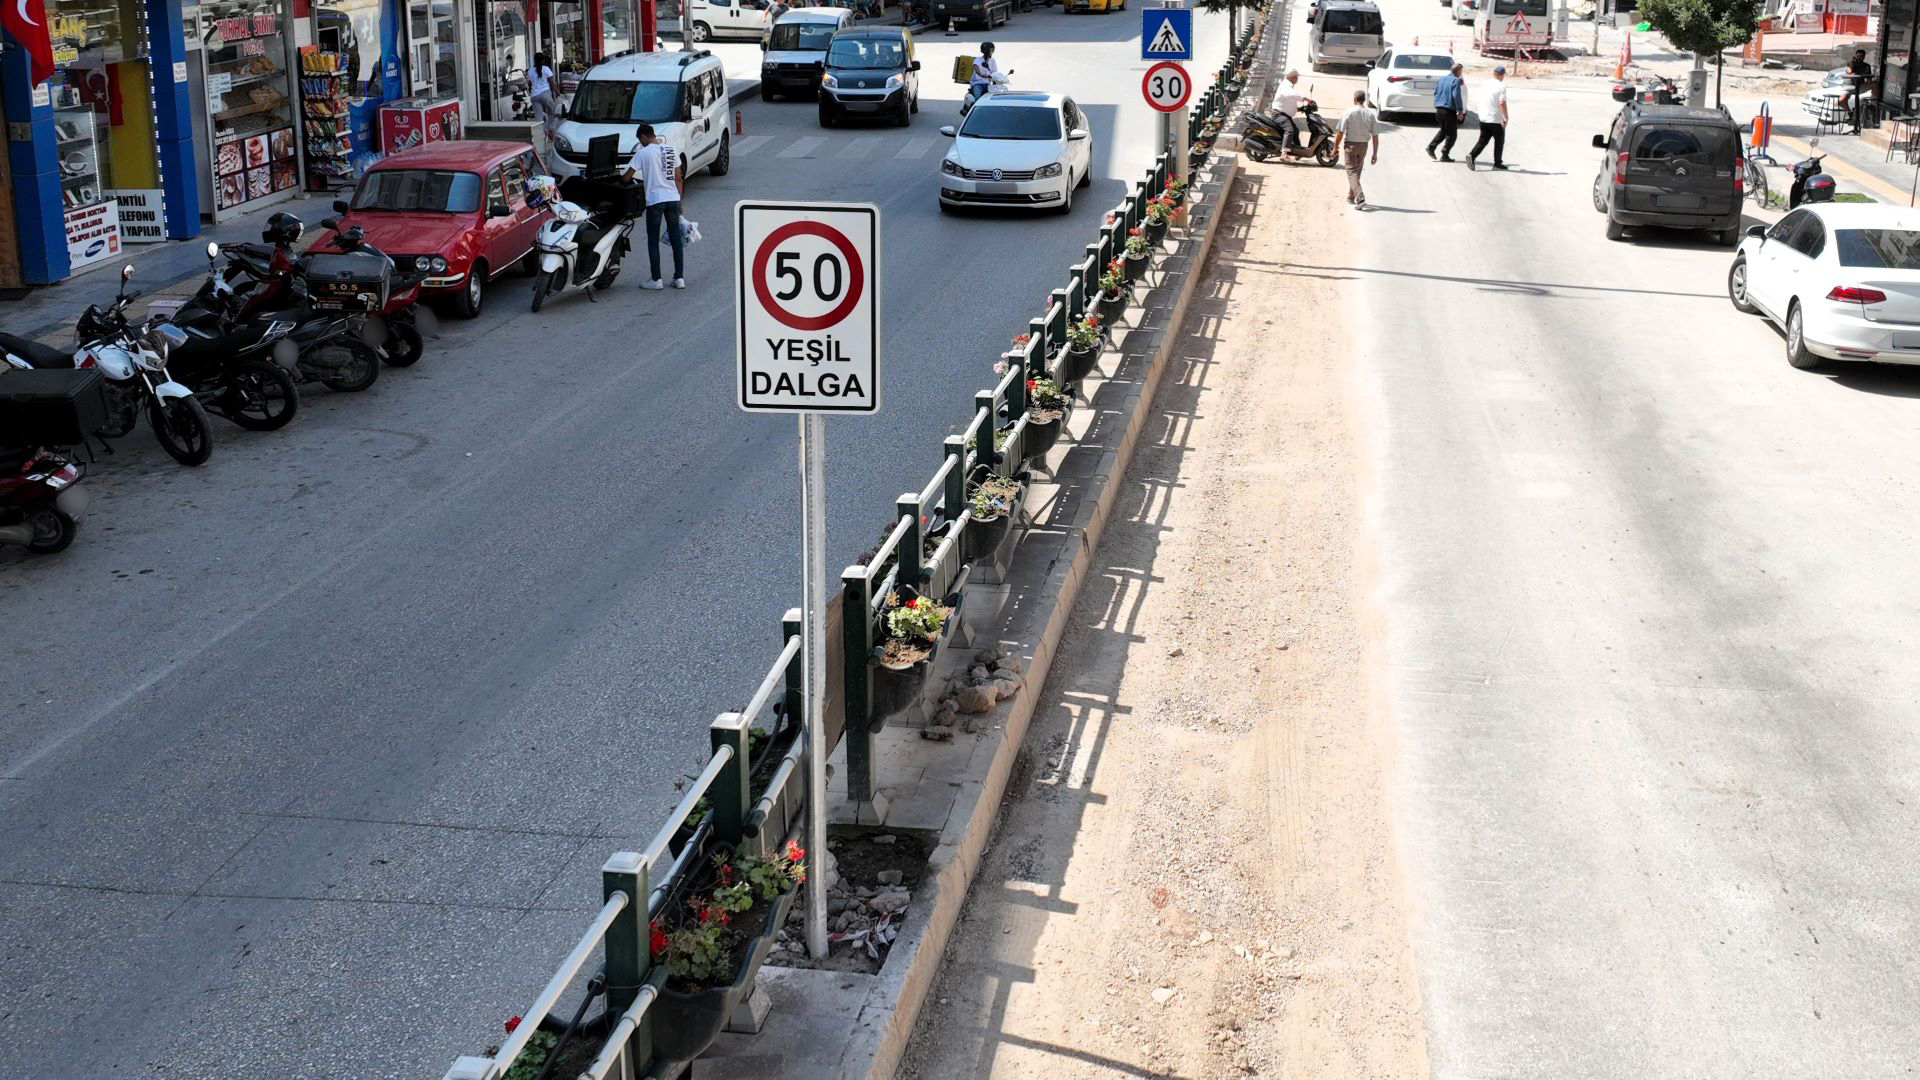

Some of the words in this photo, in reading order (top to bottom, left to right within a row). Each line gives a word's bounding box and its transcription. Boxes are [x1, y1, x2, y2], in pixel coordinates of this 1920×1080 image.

[1152, 76, 1182, 99] 30
[666, 146, 675, 181] ARMANI
[126, 225, 162, 237] YAPILIR
[775, 251, 842, 302] 50
[766, 334, 851, 367] YEŞİL
[751, 371, 865, 398] DALGA
